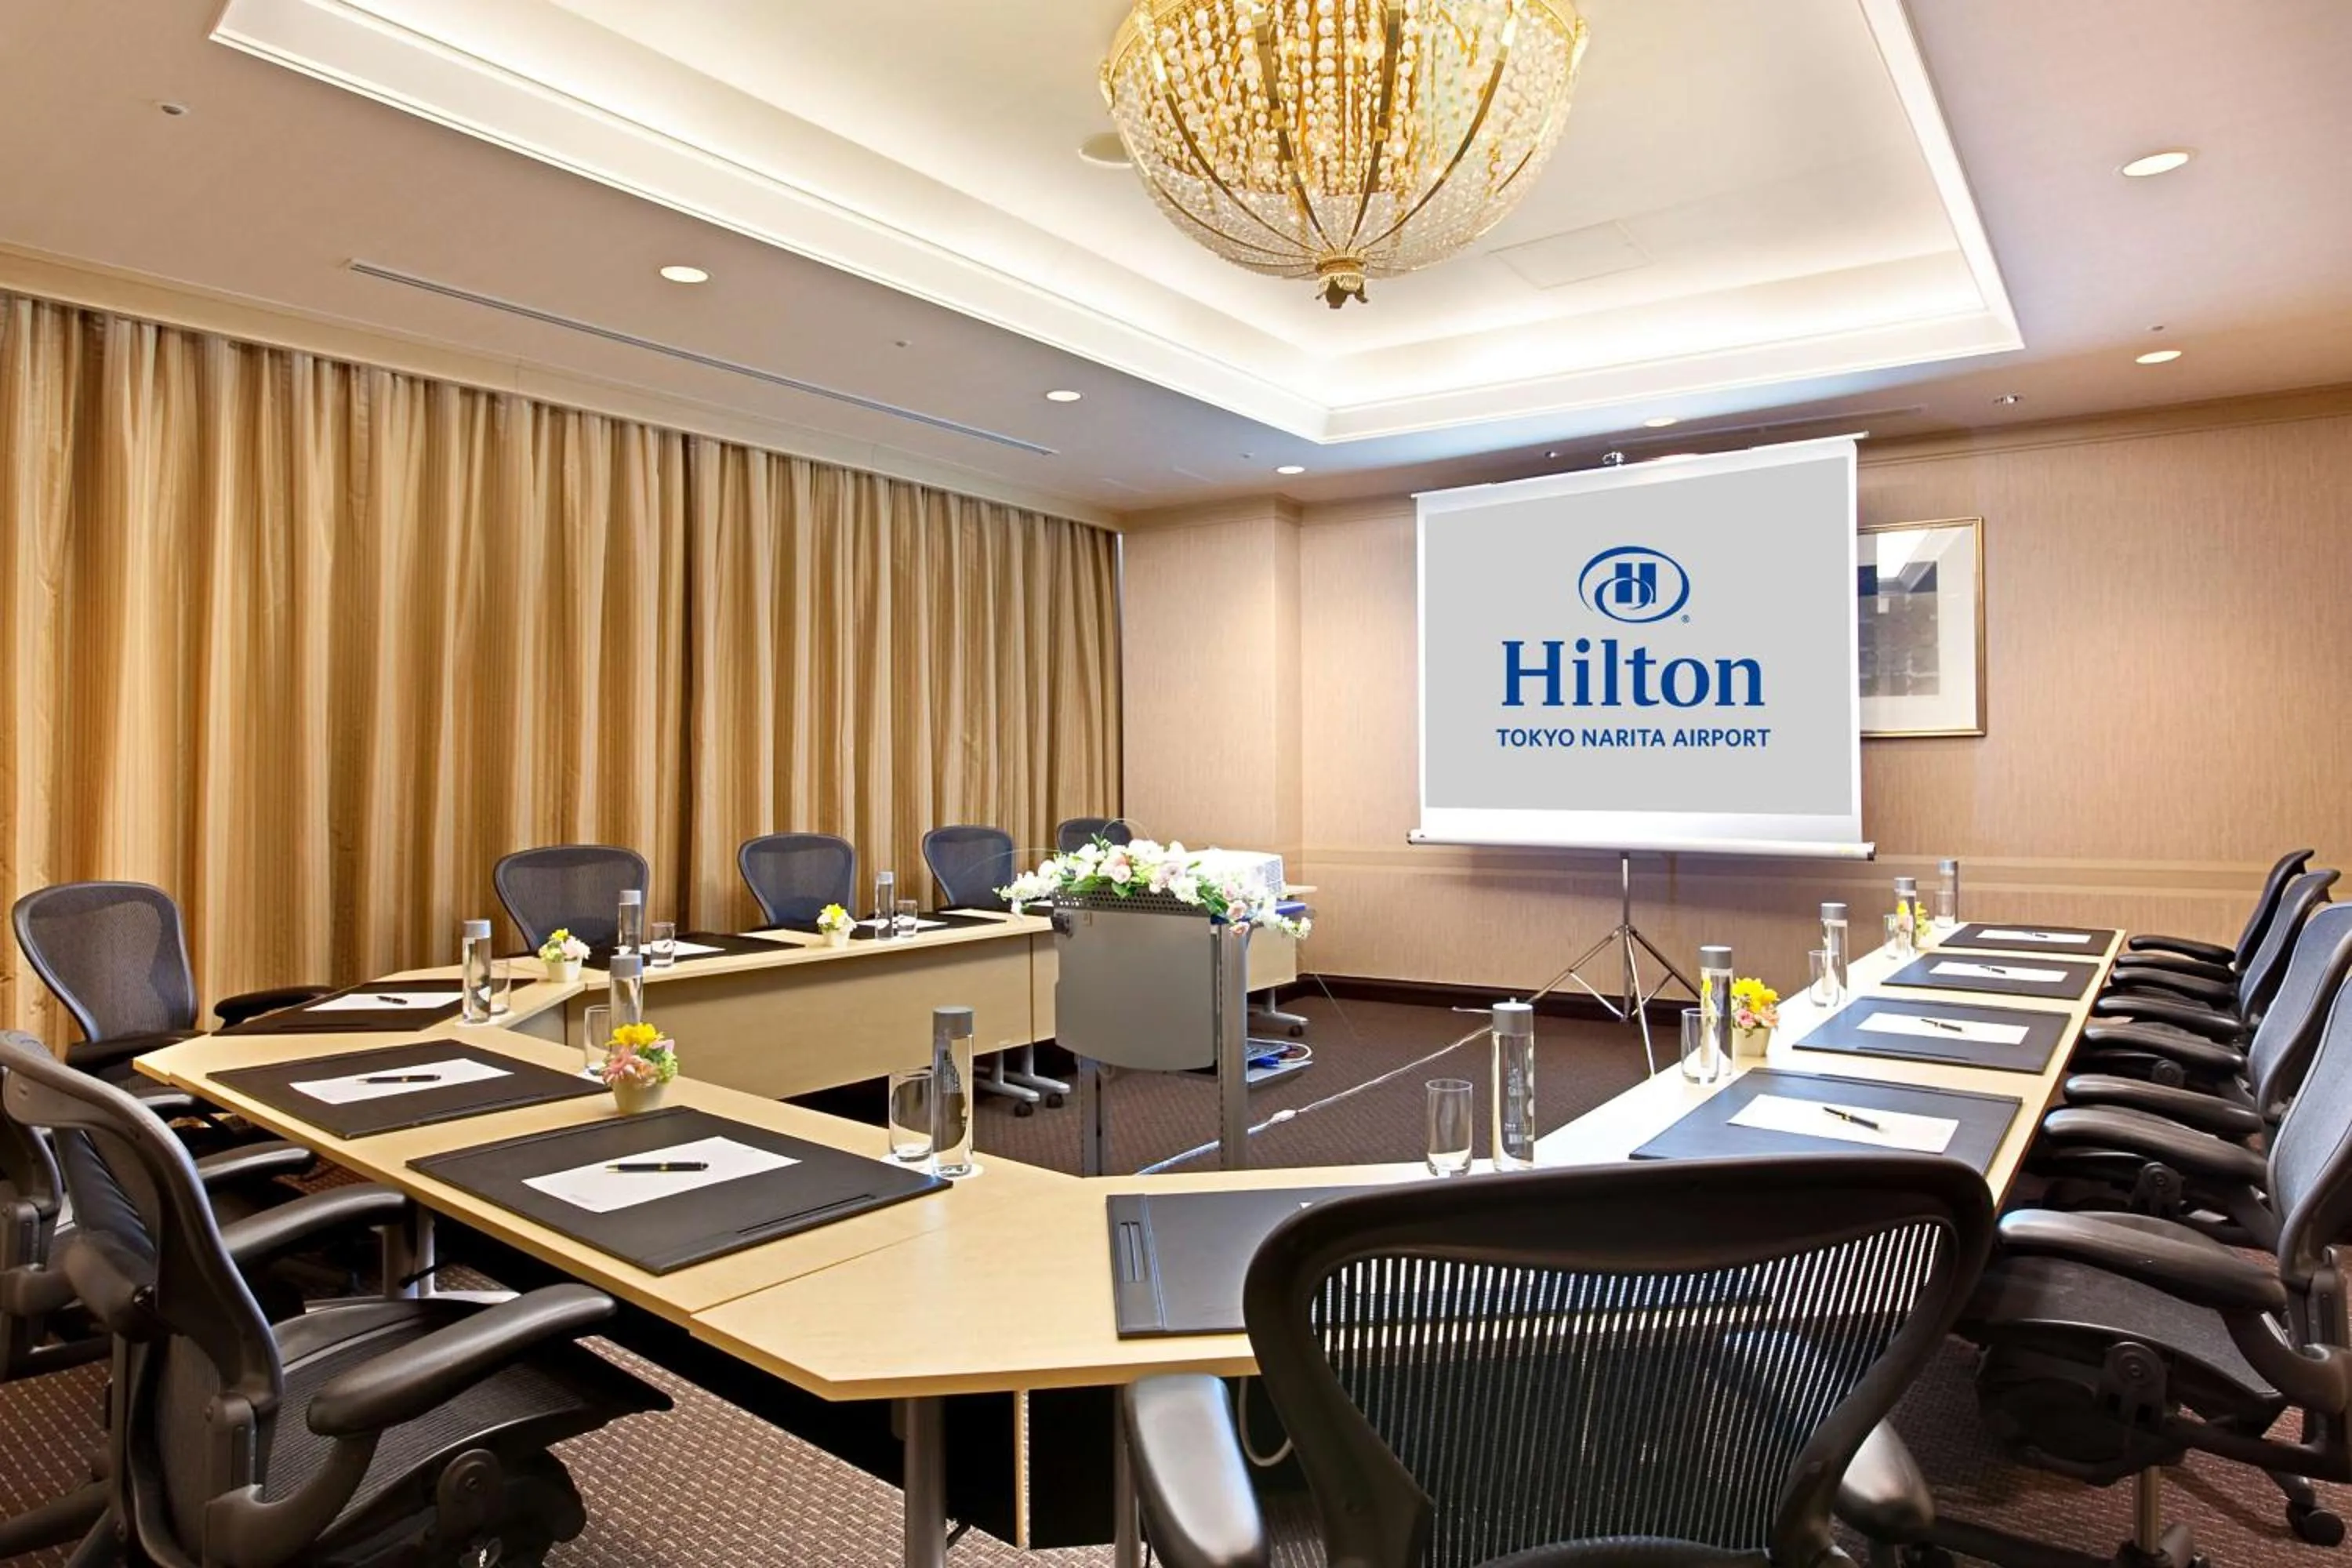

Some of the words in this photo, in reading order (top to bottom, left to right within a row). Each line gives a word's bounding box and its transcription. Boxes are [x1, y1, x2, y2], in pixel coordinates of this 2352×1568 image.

[1501, 637, 1765, 707] Hilton
[1497, 728, 1575, 747] TOKYO
[1582, 728, 1666, 747] NARITA
[1673, 728, 1770, 747] AIRPORT
